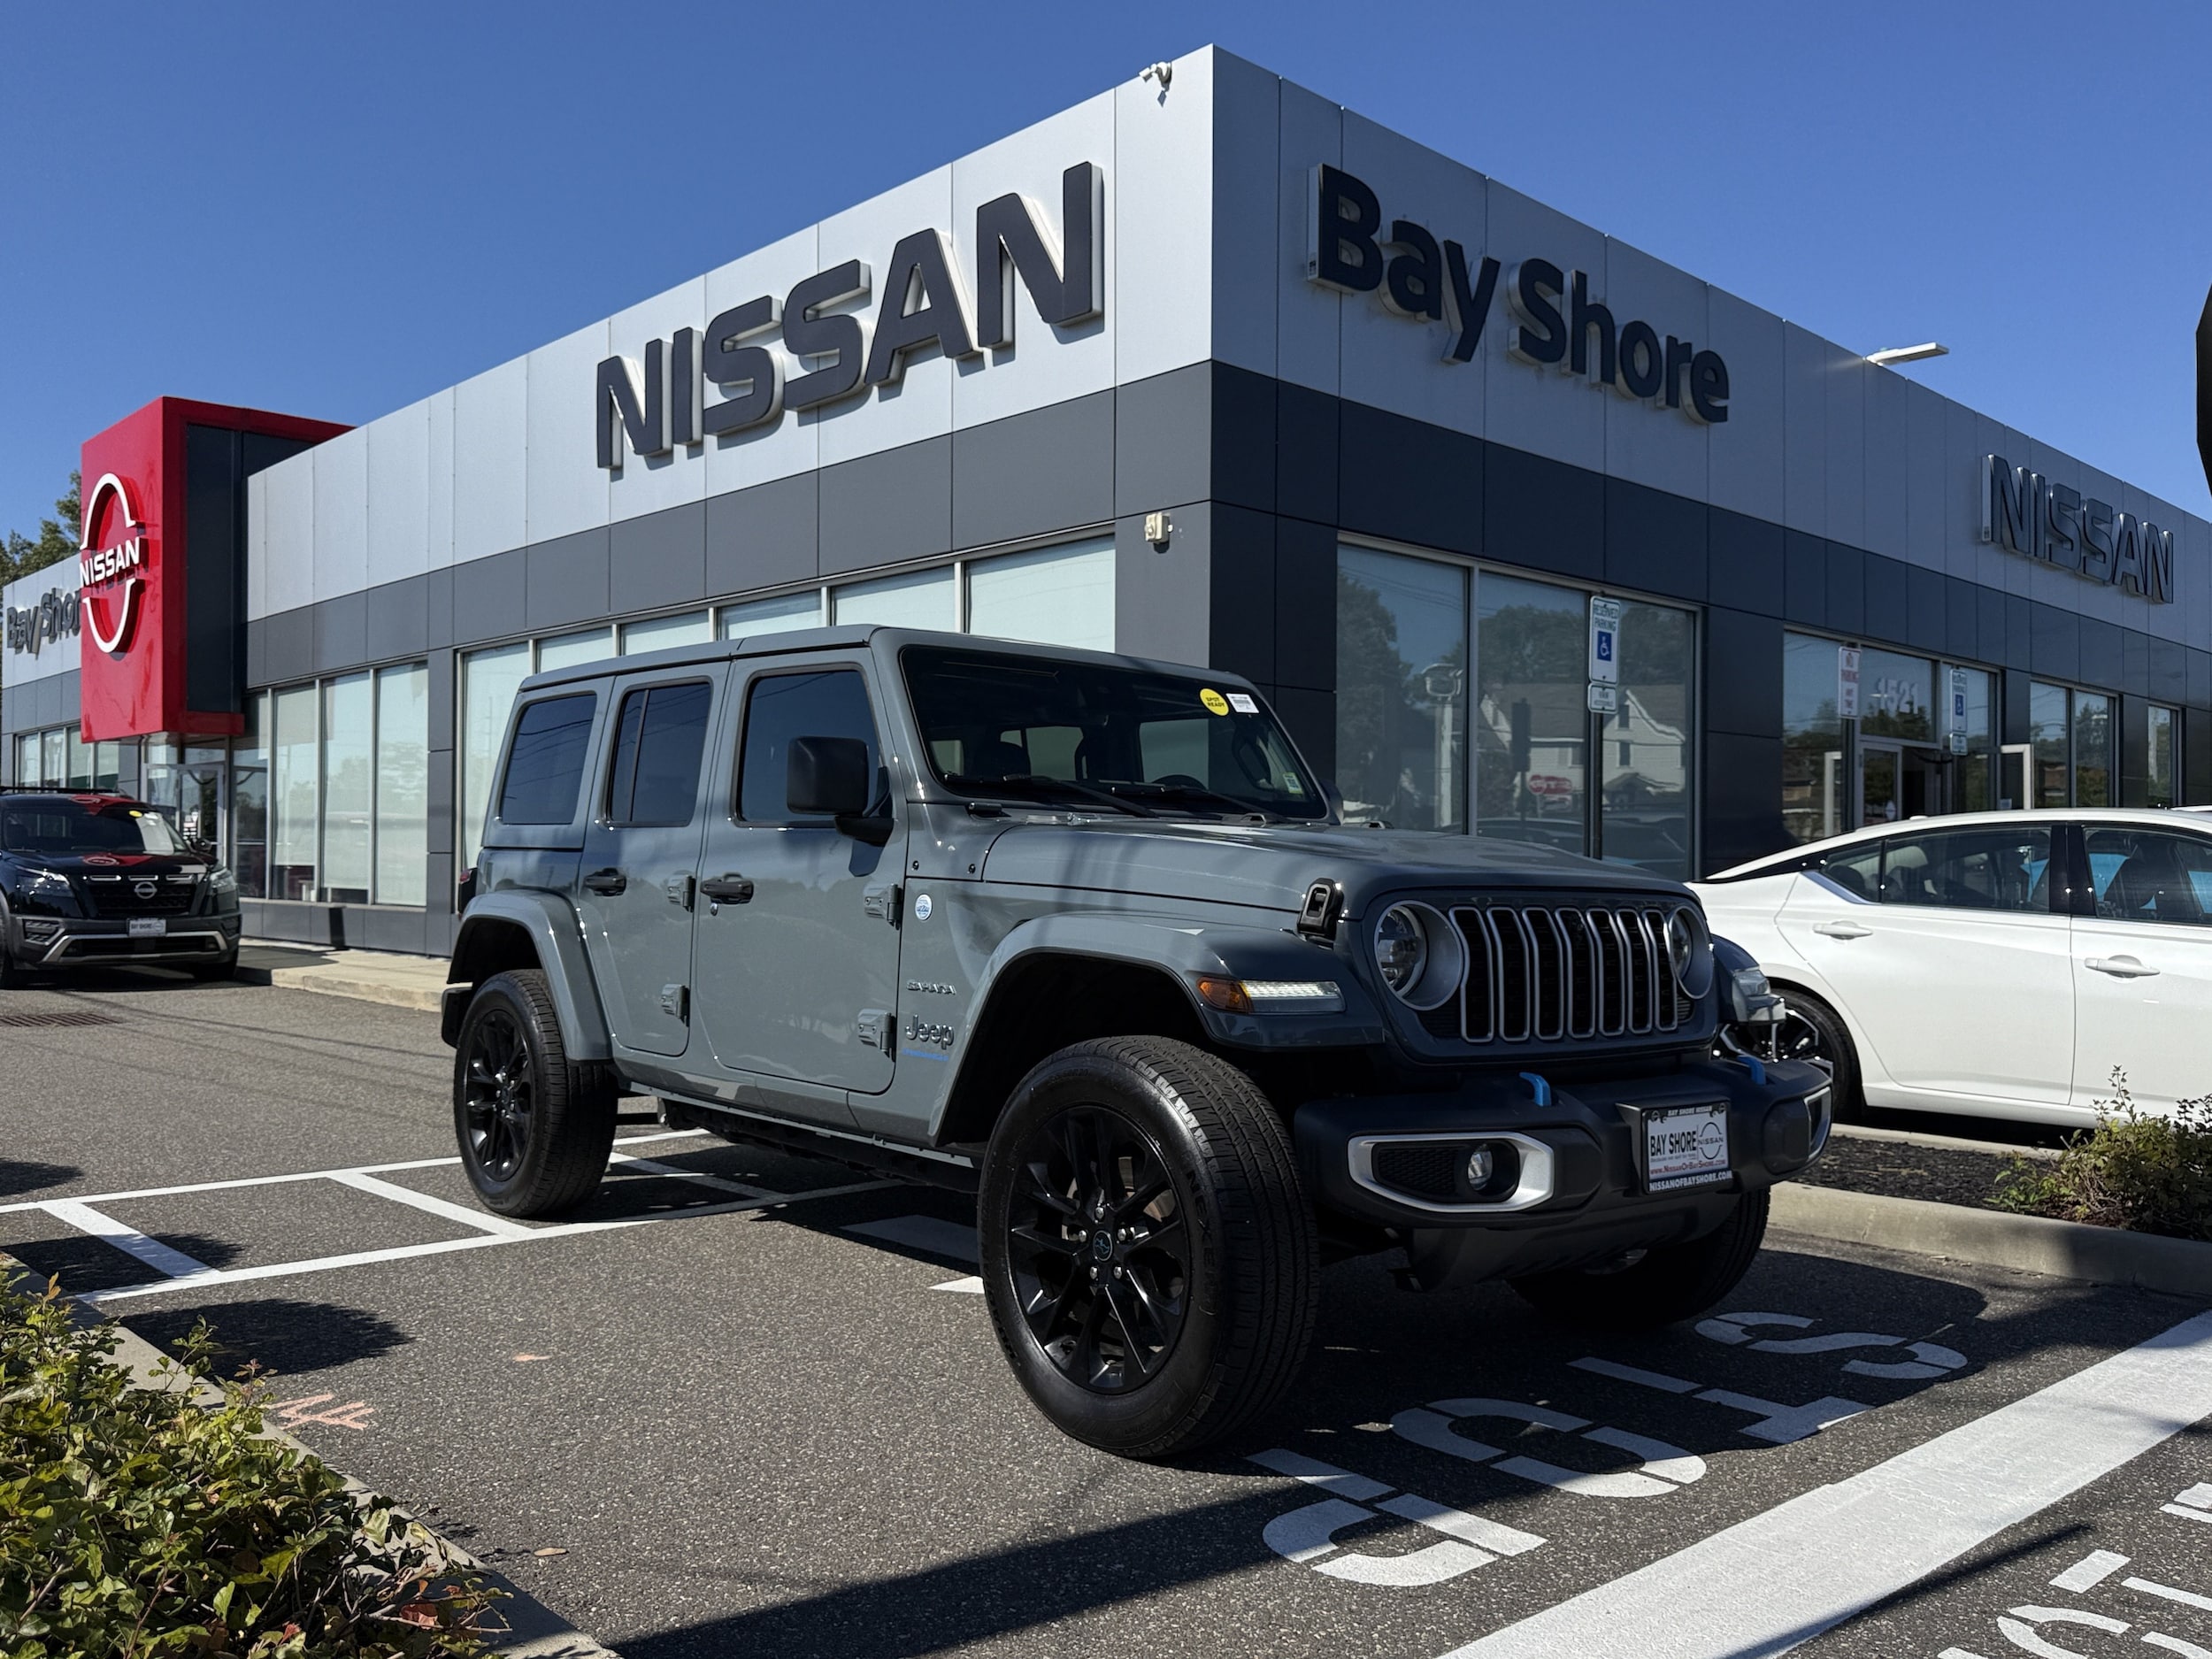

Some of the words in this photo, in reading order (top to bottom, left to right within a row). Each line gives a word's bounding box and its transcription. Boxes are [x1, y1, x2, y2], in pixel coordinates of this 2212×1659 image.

[596, 160, 1102, 469] NISSAN
[1310, 163, 1502, 364] Bay
[1509, 257, 1730, 425] Shore
[1983, 454, 2174, 604] NISSAN
[80, 536, 140, 588] NISSAN
[7, 605, 42, 657] Bay
[41, 588, 81, 639] Shor
[1876, 677, 1919, 718] 1521
[906, 980, 956, 995] SAHARA
[905, 1014, 954, 1050] Jeep
[1650, 1133, 1667, 1156] BAY
[1669, 1131, 1697, 1154] SHORE
[1649, 1171, 1733, 1192] NISSANOFBAYSHORE.COM
